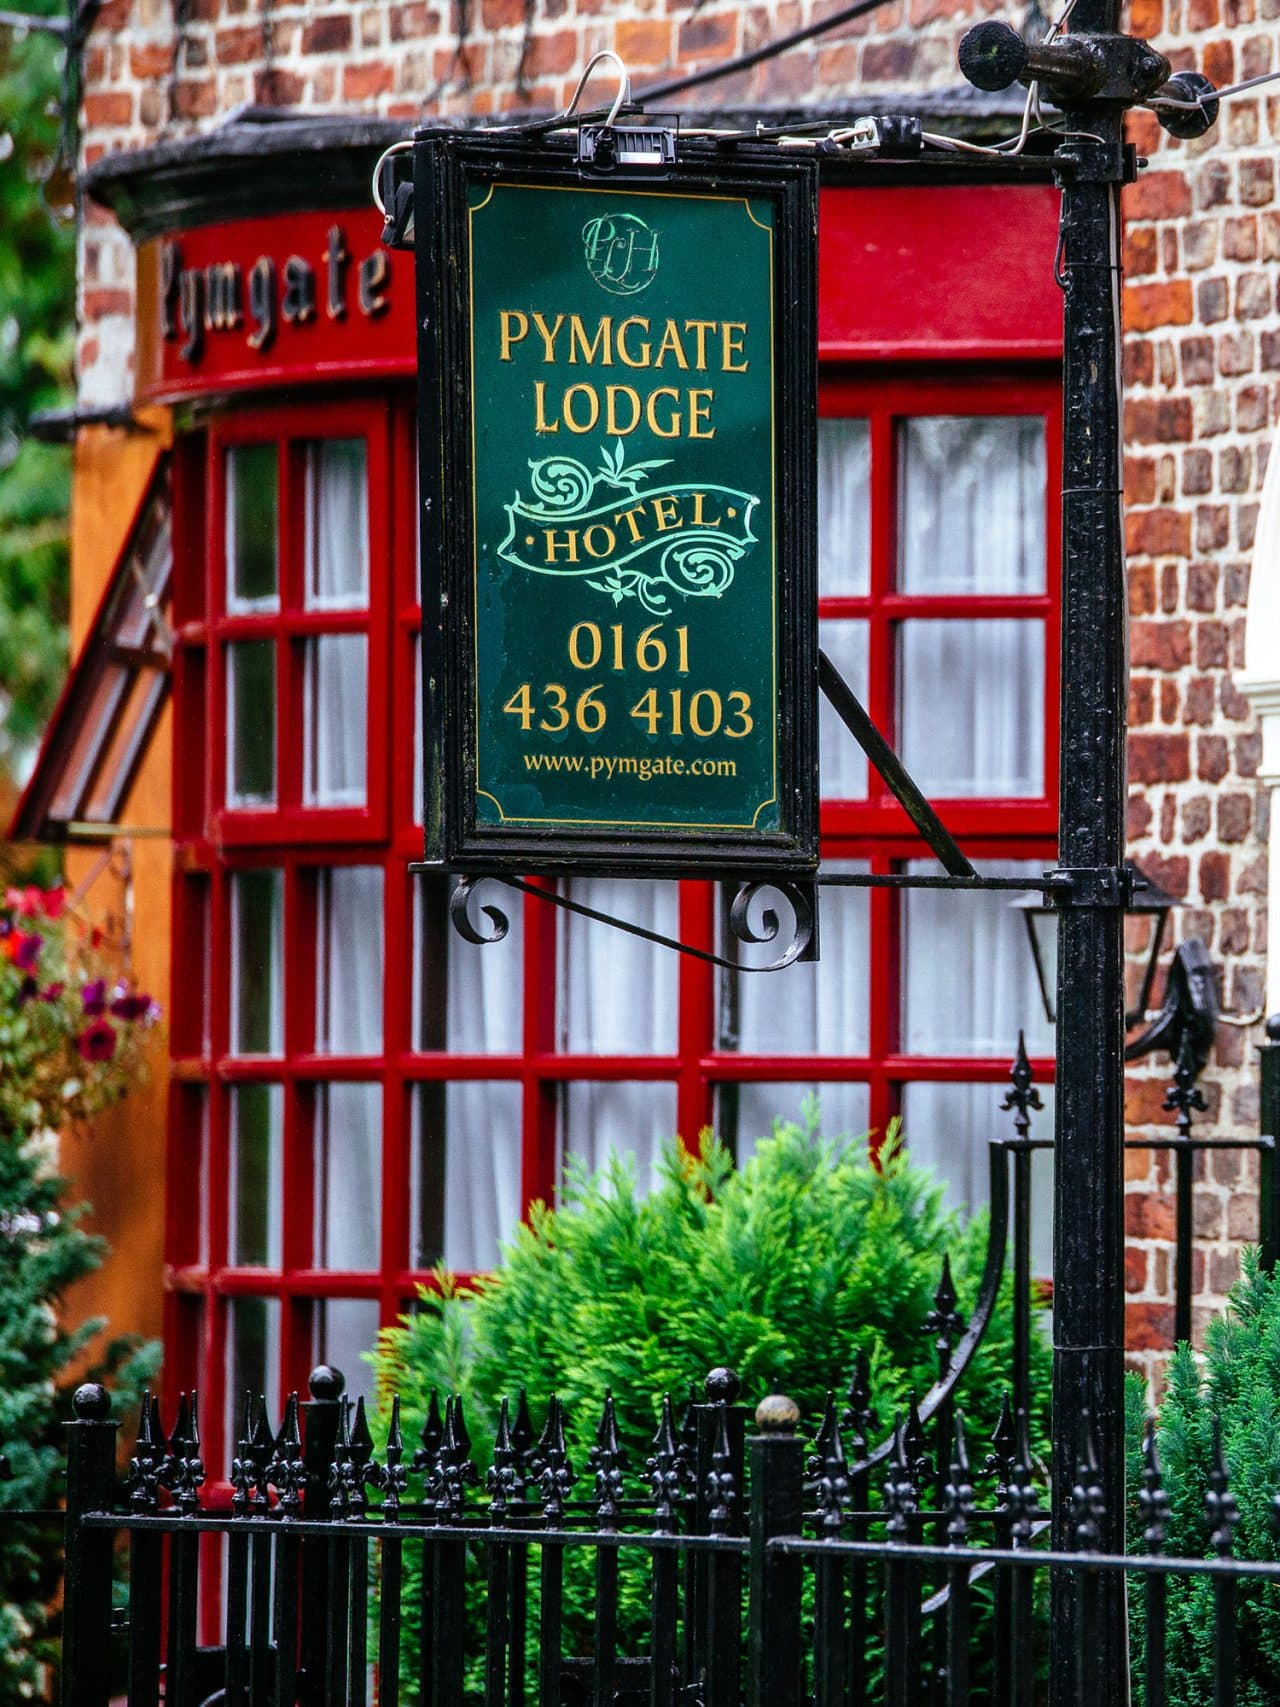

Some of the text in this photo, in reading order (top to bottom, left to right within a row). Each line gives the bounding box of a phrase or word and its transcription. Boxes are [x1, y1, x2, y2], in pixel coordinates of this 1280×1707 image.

[499, 310, 749, 373] PYMGATE
[533, 380, 716, 440] LODGE
[544, 494, 721, 562] HOTEL
[568, 621, 690, 672] 0161
[503, 684, 753, 738] 436 4103
[524, 754, 737, 780] www.pymgate.com
